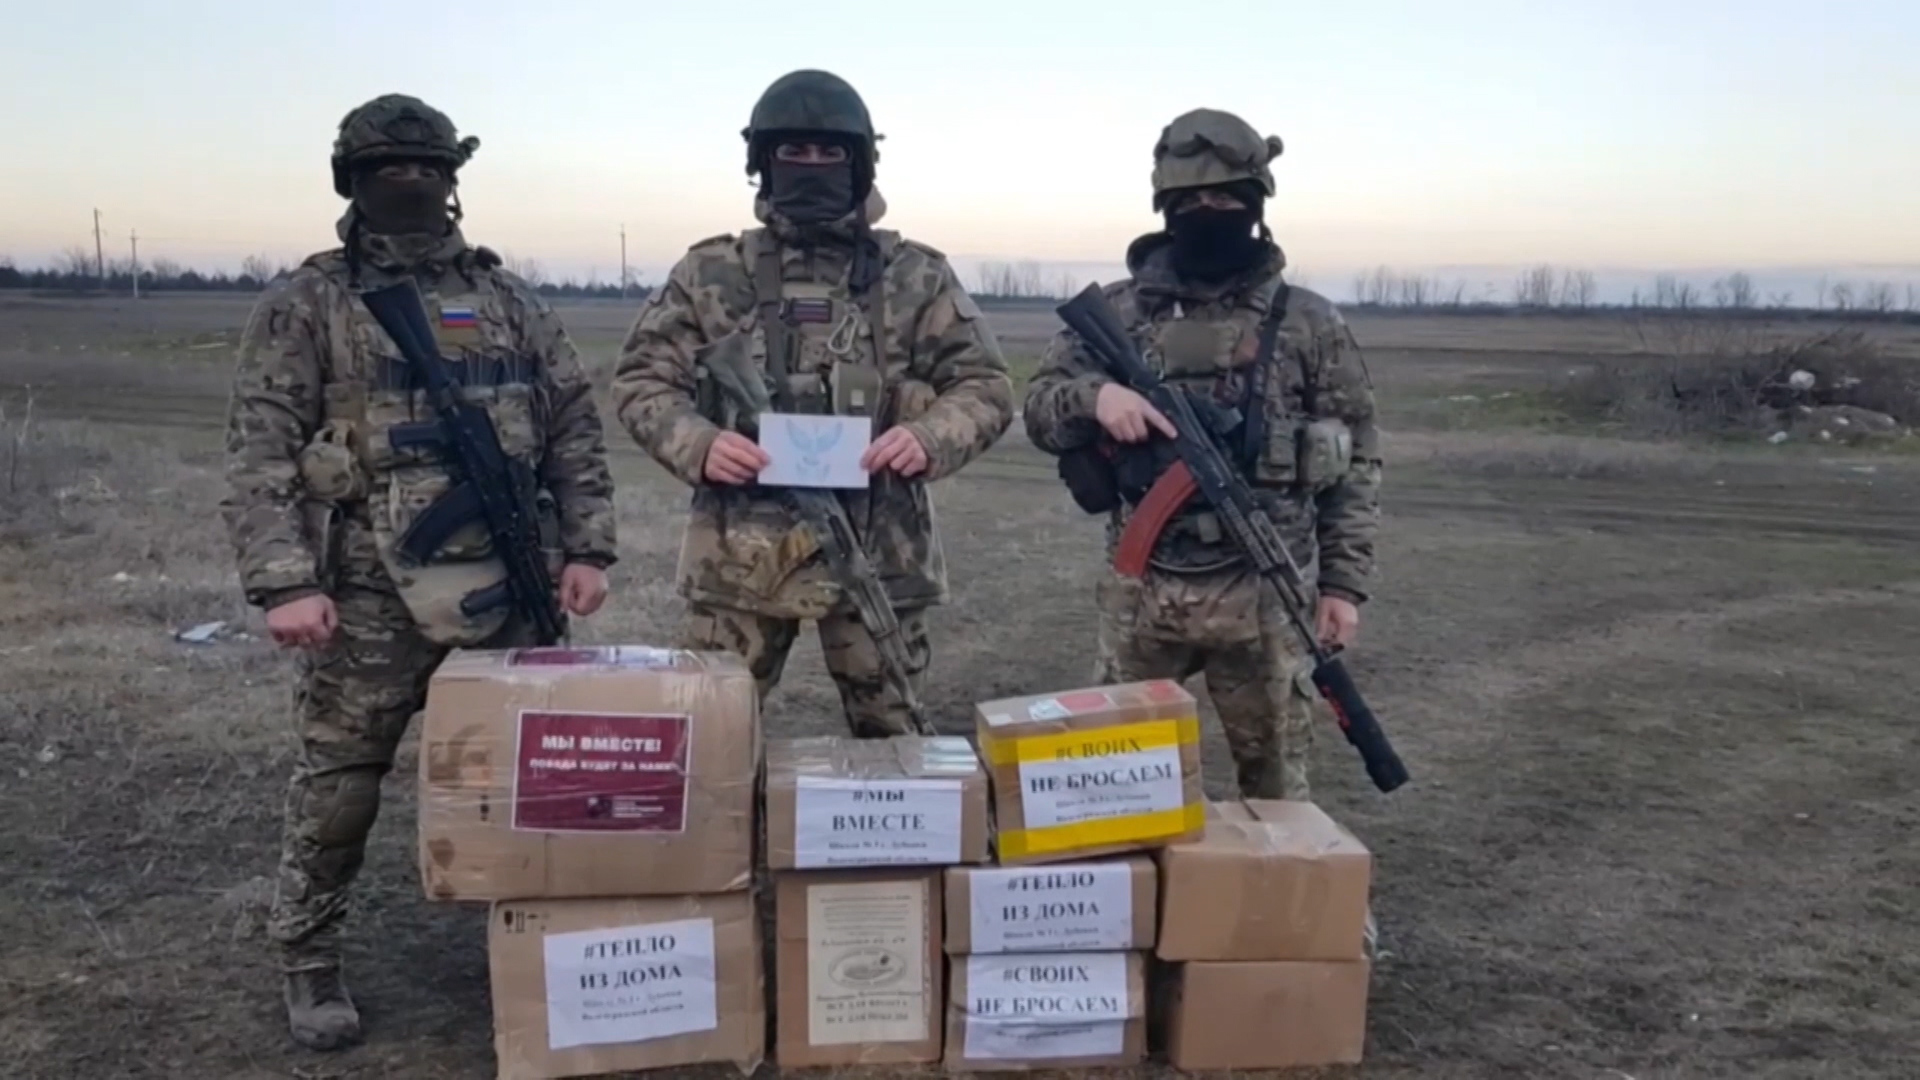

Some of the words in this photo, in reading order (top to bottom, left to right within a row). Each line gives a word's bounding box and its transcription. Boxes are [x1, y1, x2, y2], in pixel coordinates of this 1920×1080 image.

[541, 735, 575, 750] МЫ
[579, 736, 662, 752] ВМЕСТЕ!
[1056, 737, 1142, 761] #СВОИХ
[1030, 776, 1060, 793] НЕ
[1067, 763, 1173, 790] БРОСАЕМ
[852, 789, 904, 802] #МЫ
[832, 814, 926, 831] ВМЕСТЕ
[1007, 871, 1095, 891] #ТЕПЛО
[1003, 905, 1029, 921] ИЗ
[1034, 901, 1100, 921] ДОМА
[584, 934, 676, 959] #ТЕПЛО
[580, 972, 608, 990] ИЗ
[613, 964, 682, 989] ДОМА
[1003, 965, 1089, 982] #СВОИХ
[976, 997, 1003, 1014] НЕ
[1013, 997, 1118, 1013] БРОСАЕМ
